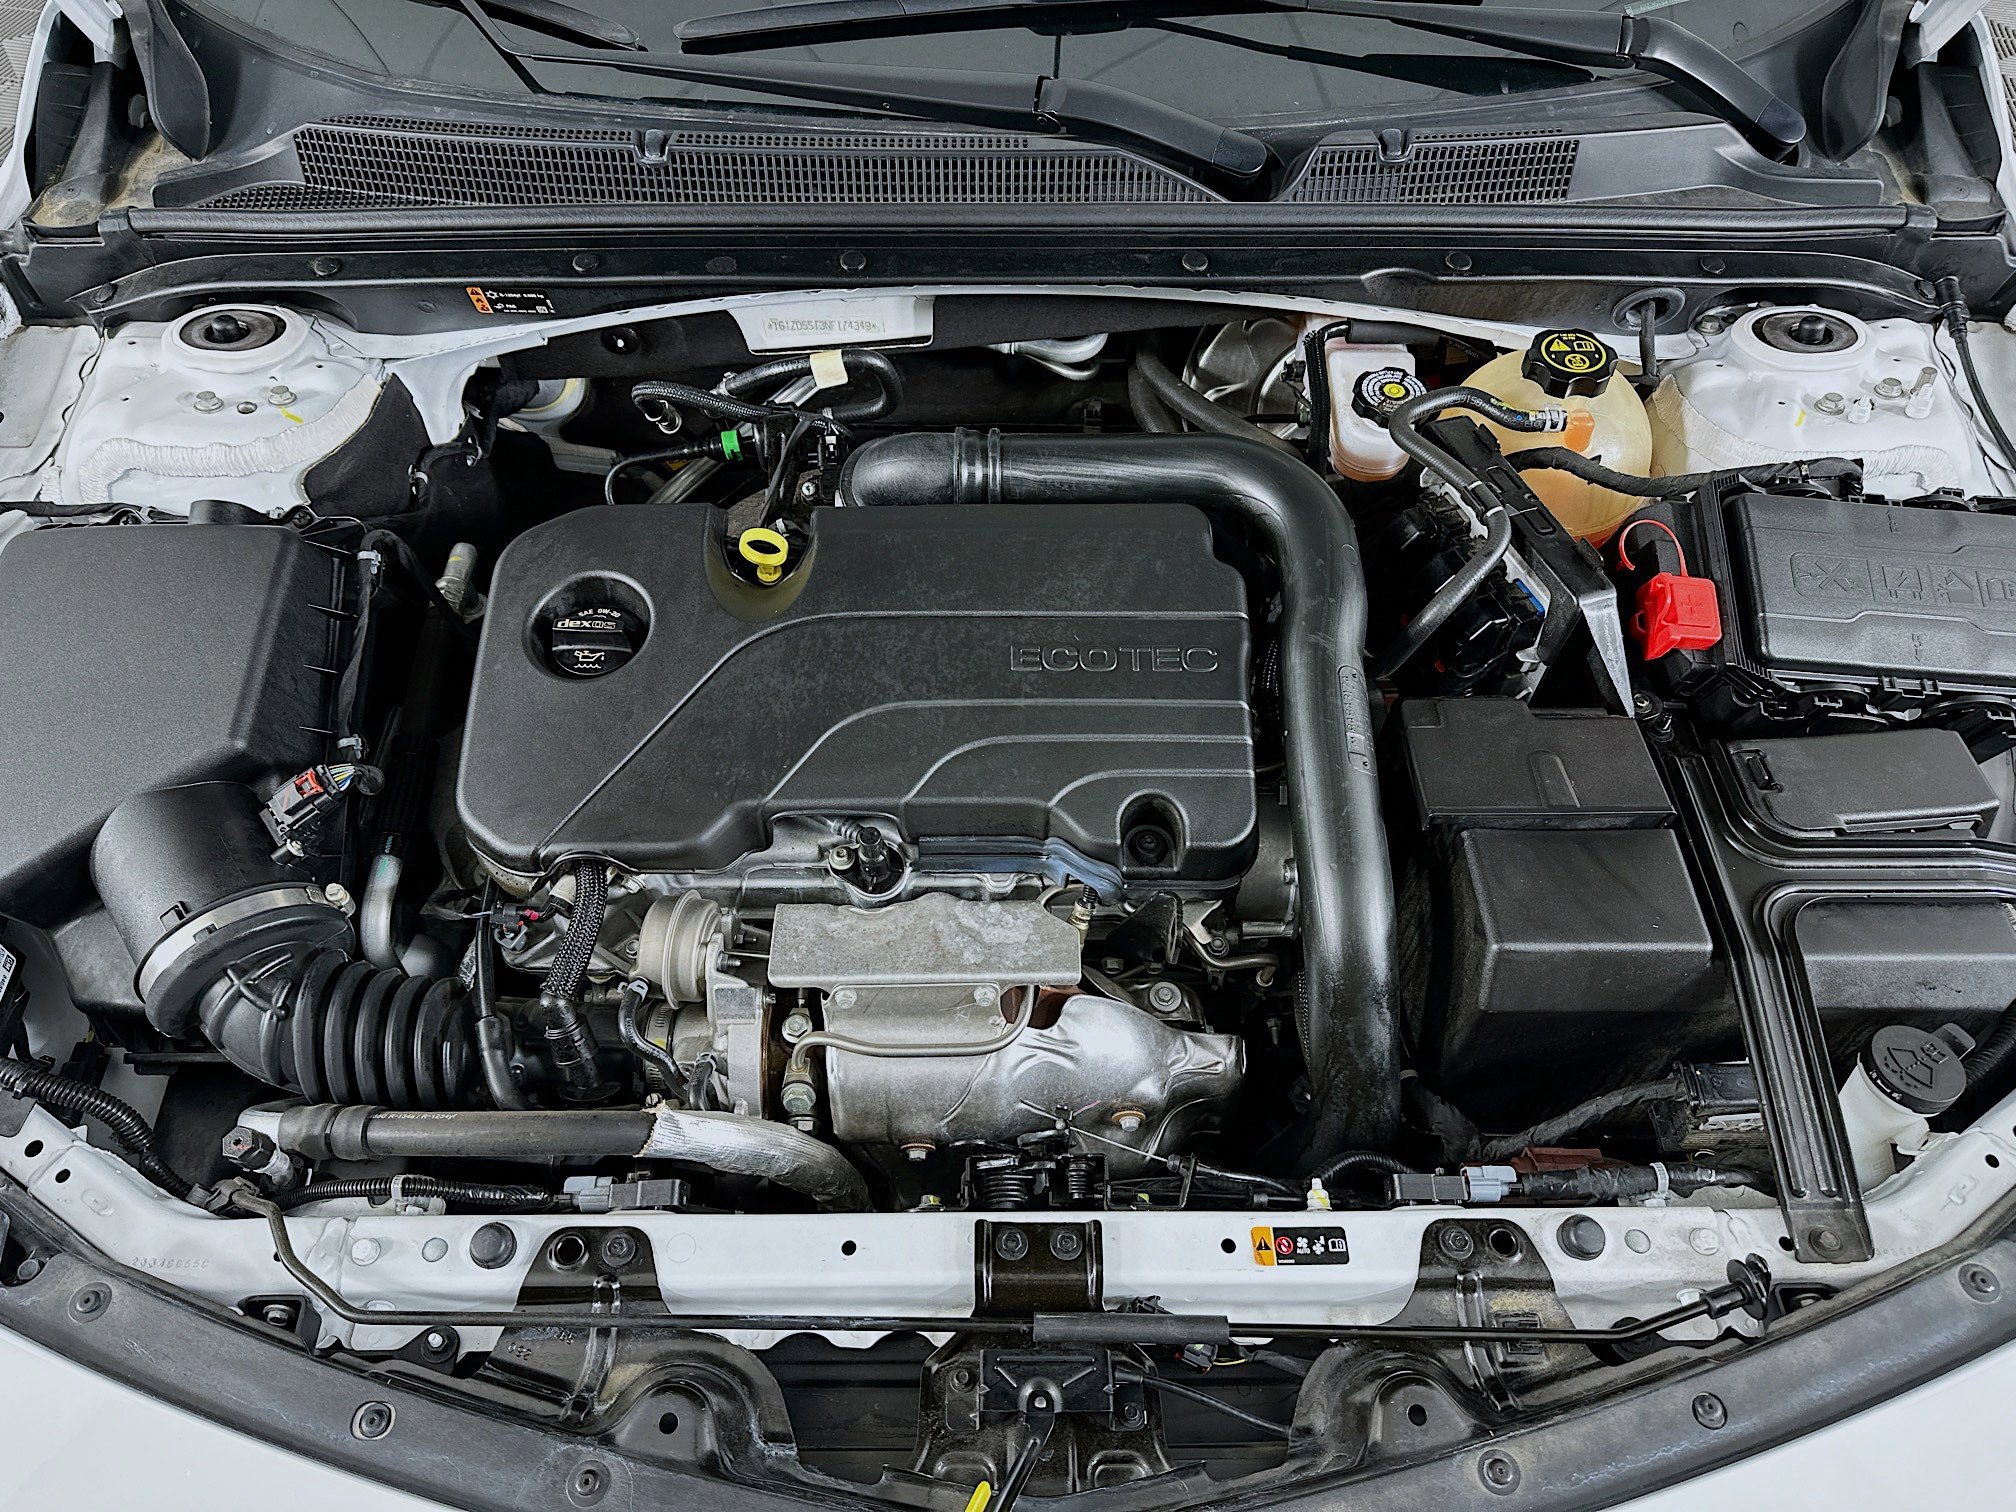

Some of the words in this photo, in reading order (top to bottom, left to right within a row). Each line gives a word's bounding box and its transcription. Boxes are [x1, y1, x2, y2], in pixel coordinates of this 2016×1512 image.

[578, 608, 594, 617] SAE
[597, 608, 621, 618] 0W-20
[557, 619, 617, 629] dexos
[1010, 645, 1219, 672] ECOTEC
